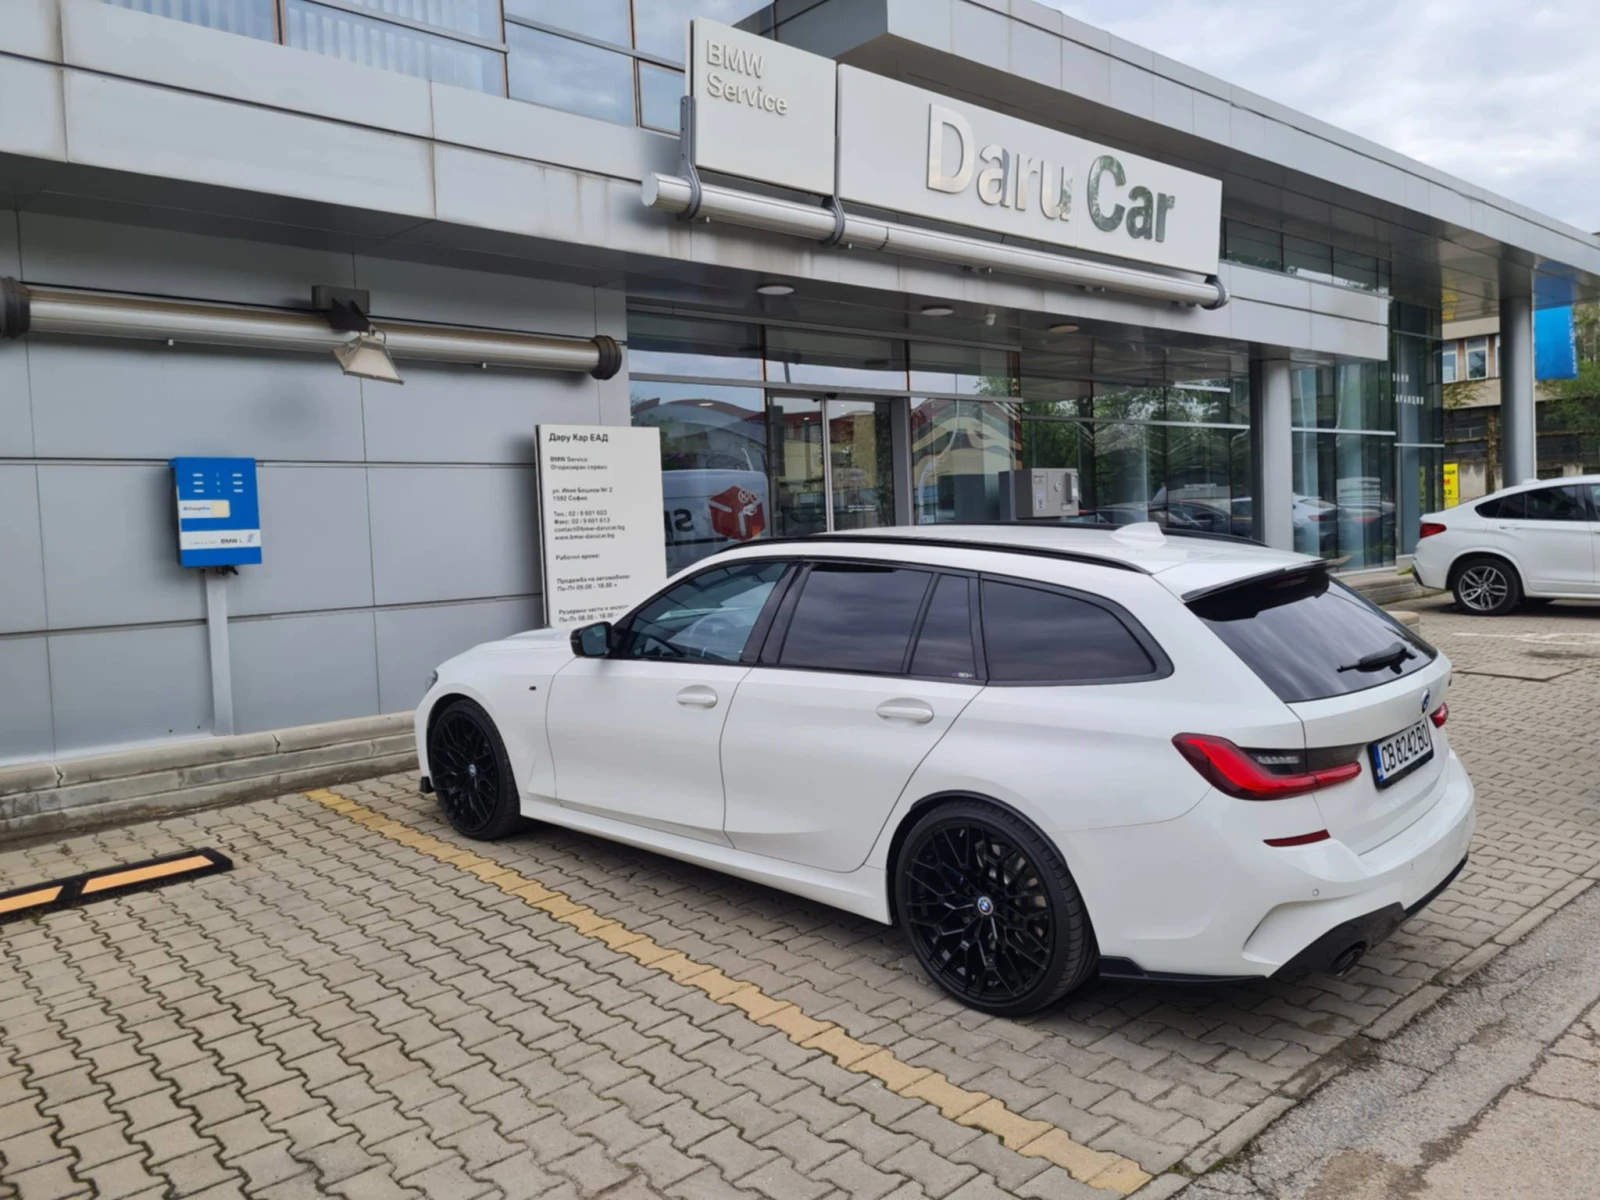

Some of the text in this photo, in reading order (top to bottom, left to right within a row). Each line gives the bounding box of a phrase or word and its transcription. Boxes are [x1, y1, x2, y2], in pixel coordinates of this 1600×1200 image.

[707, 39, 764, 79] BMW
[707, 72, 787, 117] Service
[926, 103, 1176, 243] Daru Car
[549, 432, 609, 444] Дару Кар ЕАД
[1381, 743, 1396, 772] CB
[1395, 730, 1418, 763] 8242
